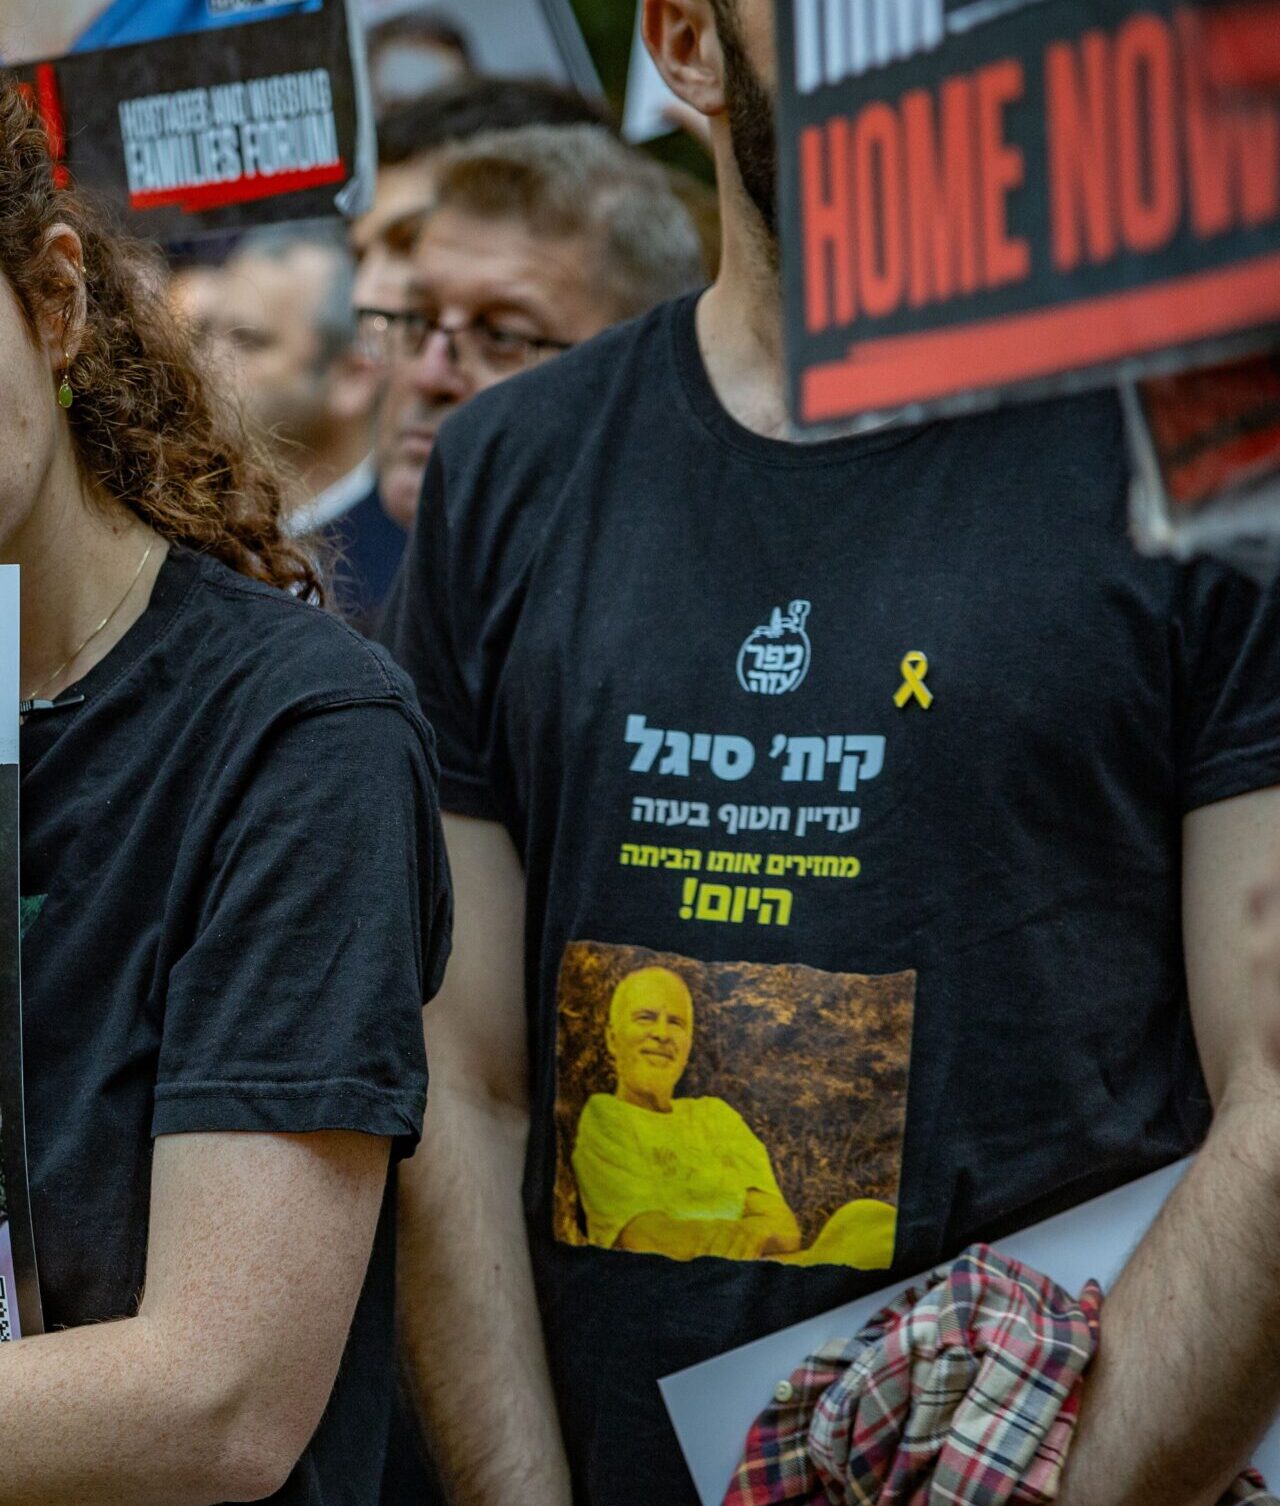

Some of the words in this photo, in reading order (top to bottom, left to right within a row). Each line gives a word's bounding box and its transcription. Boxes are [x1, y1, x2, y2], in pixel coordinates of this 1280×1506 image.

[124, 128, 242, 193] FAMILIES
[240, 110, 339, 179] FORUM
[799, 59, 1030, 334] HOME
[1045, 10, 1280, 272] NOW
[746, 644, 804, 671] כפר
[747, 669, 801, 695] עזה
[624, 714, 756, 781] סיגל
[631, 796, 711, 828] בעזה
[717, 803, 791, 835] חטוף
[795, 806, 861, 837] עדיין
[619, 842, 703, 870] הביתה
[706, 850, 761, 875] אותו
[765, 854, 861, 879] מחזירים
[678, 877, 793, 926] היום!
